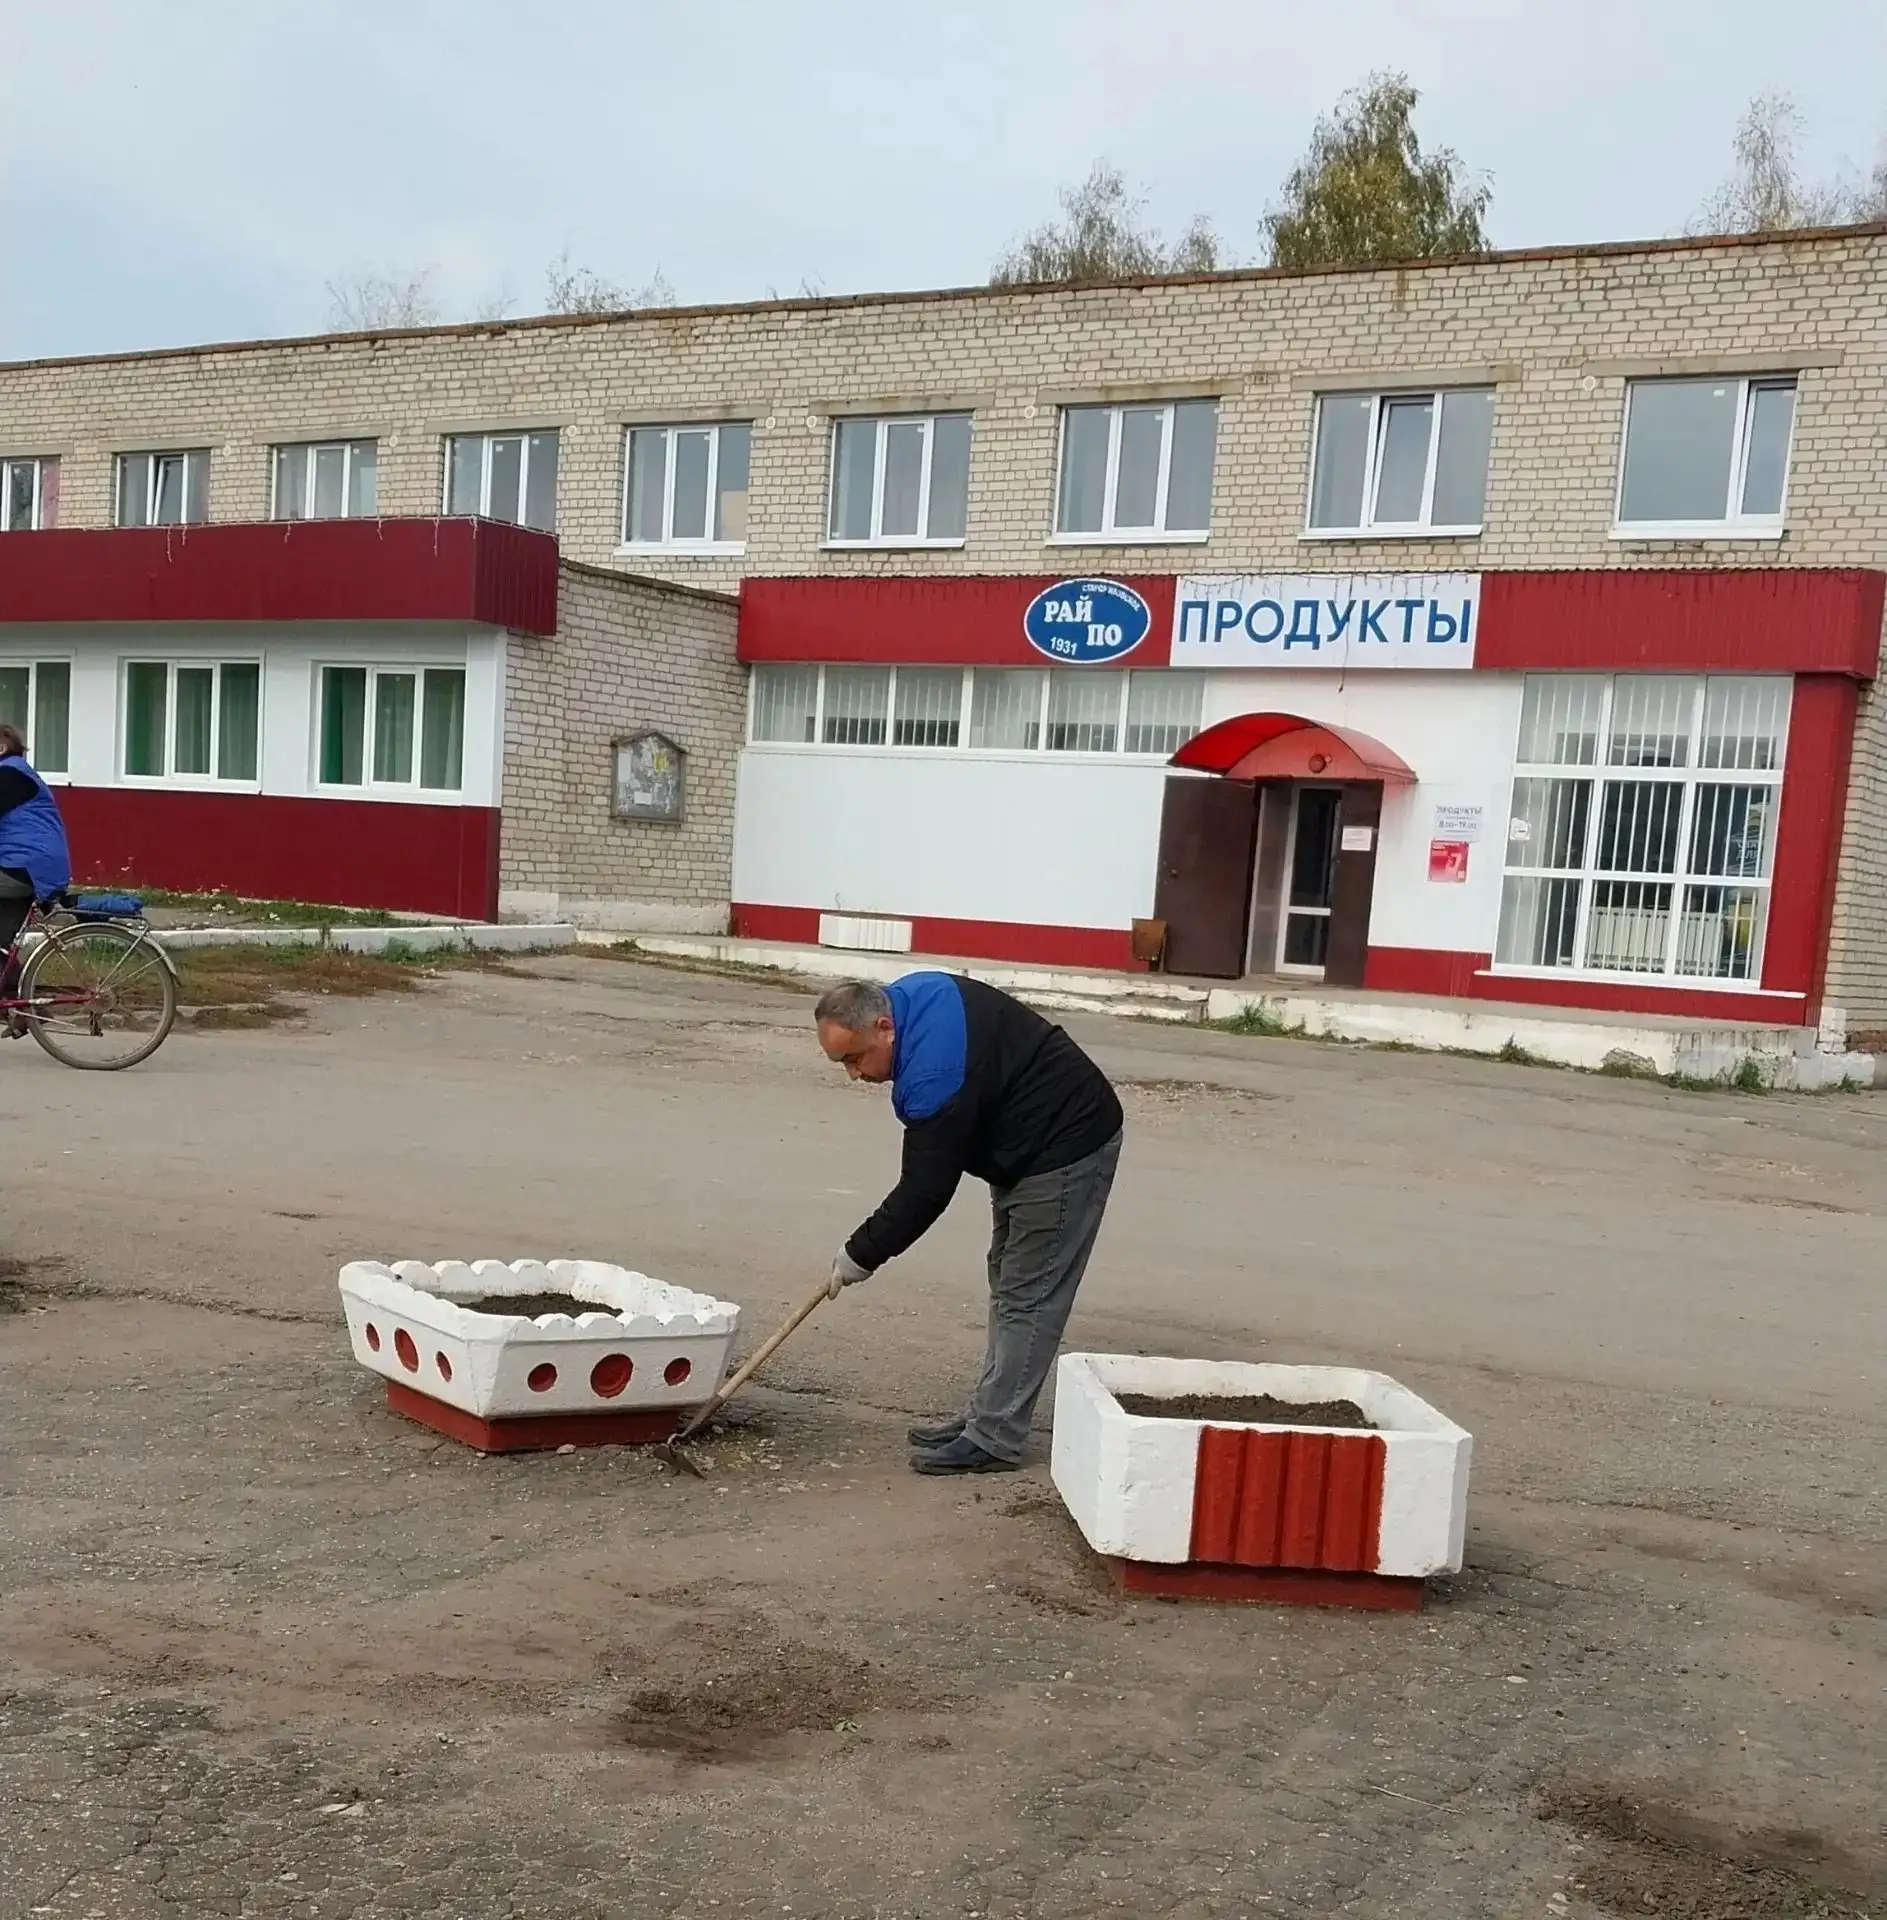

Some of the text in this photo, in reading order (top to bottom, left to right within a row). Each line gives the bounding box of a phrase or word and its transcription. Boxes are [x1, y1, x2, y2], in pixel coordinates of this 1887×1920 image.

[1044, 595, 1093, 622] РАЙ
[1086, 624, 1122, 646] ПО
[1178, 599, 1472, 650] ПРОДУКТЫ
[1050, 637, 1078, 656] 1931
[1436, 806, 1483, 815] ПРОДУКТЫ
